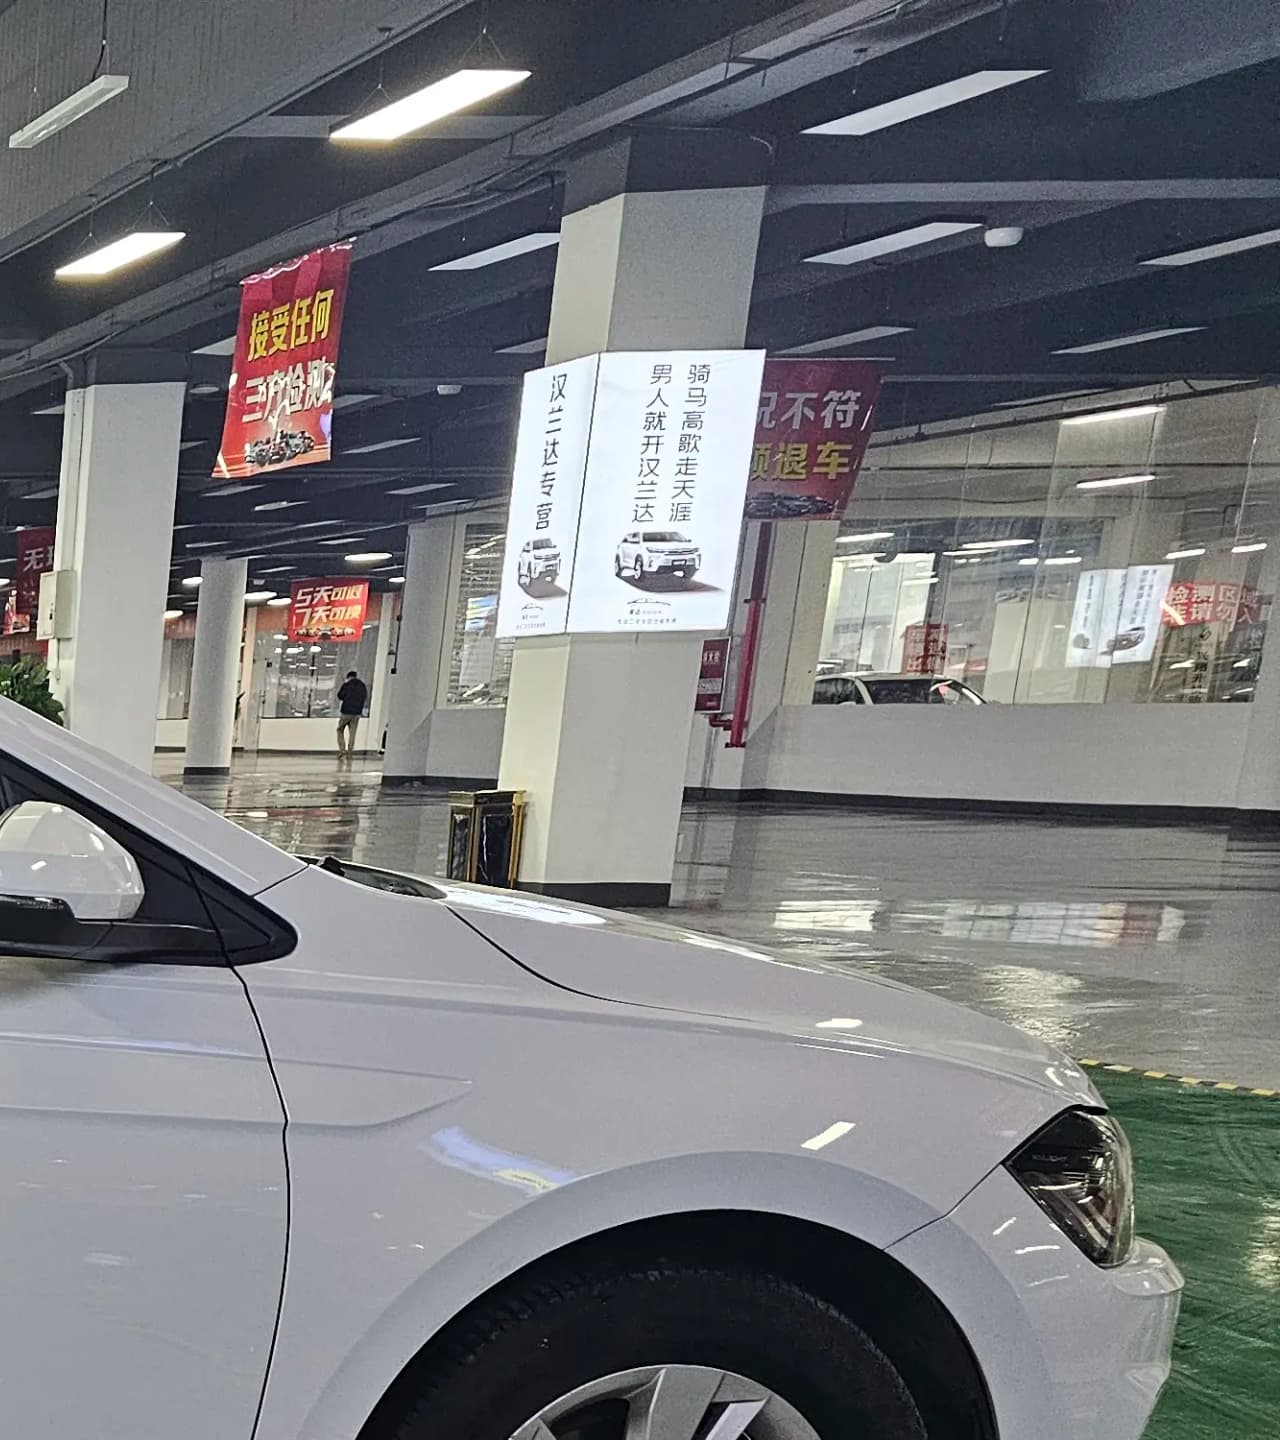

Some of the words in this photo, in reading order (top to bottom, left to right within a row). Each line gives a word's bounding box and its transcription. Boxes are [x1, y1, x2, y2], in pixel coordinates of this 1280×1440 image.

[247, 288, 335, 362] 接受任何
[535, 372, 568, 530] 汉兰达专营
[631, 364, 673, 524] 男人就开汉兰达
[668, 364, 711, 523] 骑马高歌走天涯
